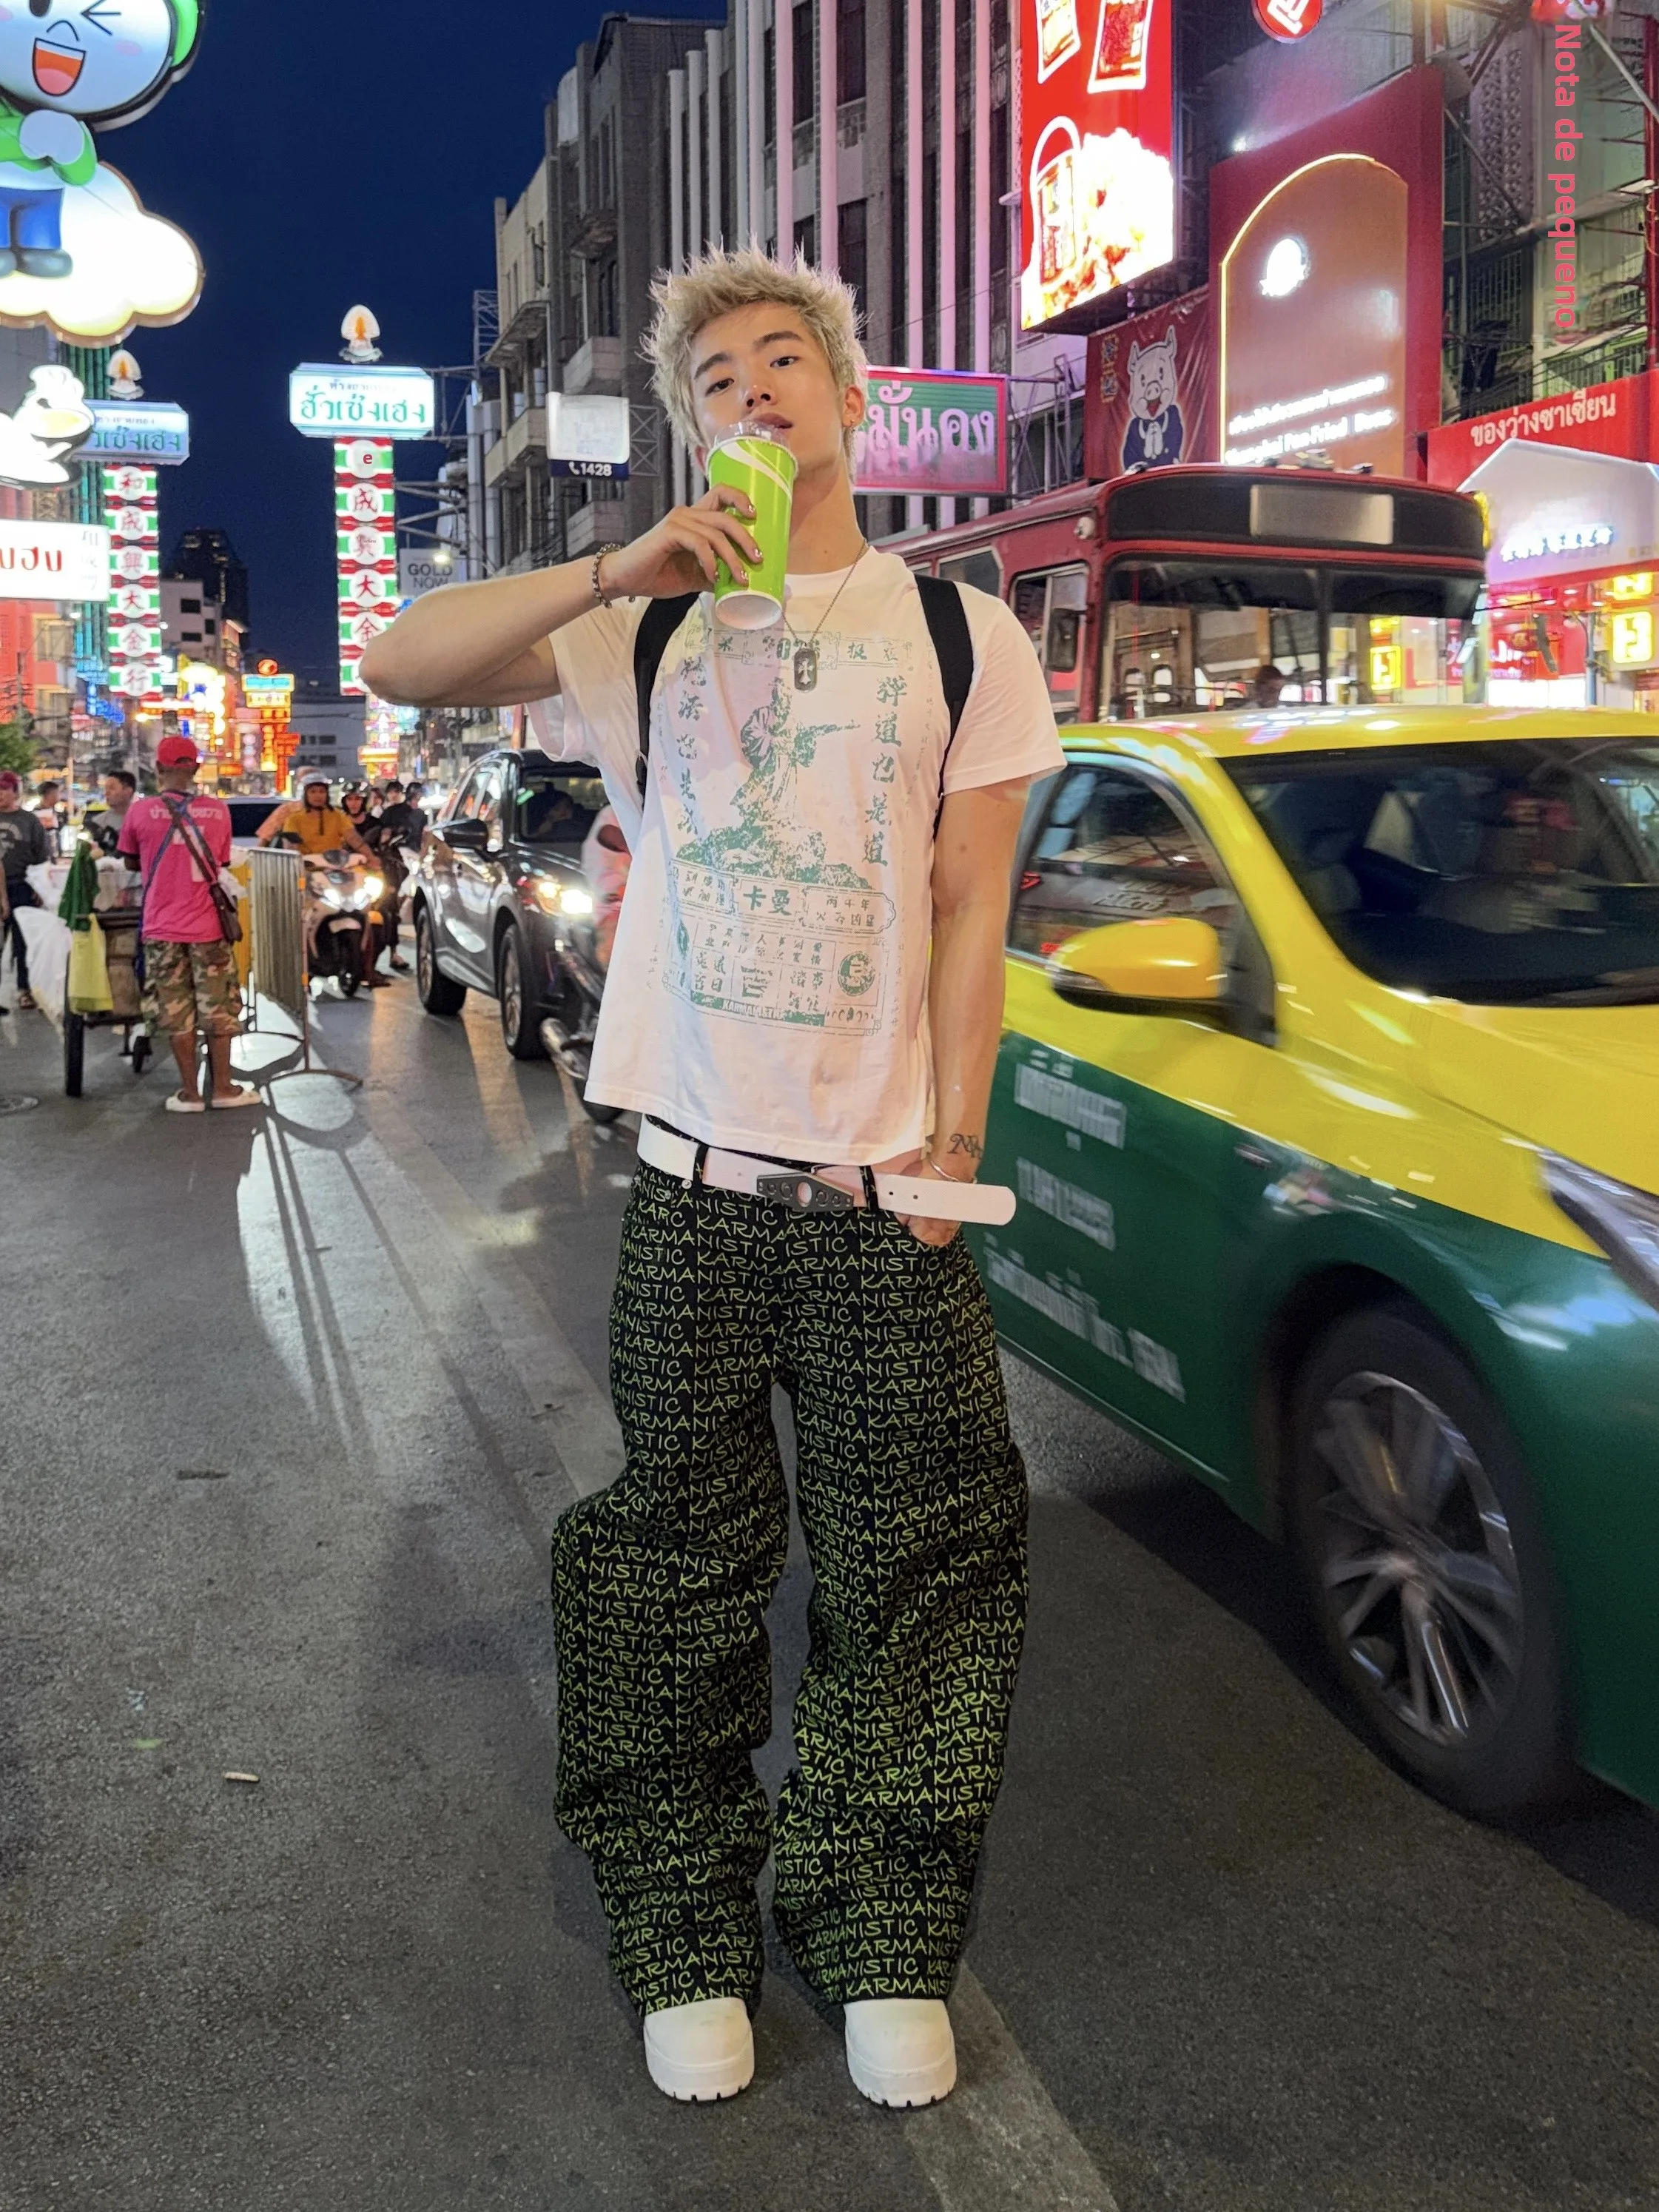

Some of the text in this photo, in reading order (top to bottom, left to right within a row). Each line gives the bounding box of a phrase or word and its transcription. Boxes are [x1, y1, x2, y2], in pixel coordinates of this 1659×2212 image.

[580, 463, 612, 476] 1428
[408, 562, 453, 576] GOLD
[785, 1254, 940, 1274] ARMANISTIC
